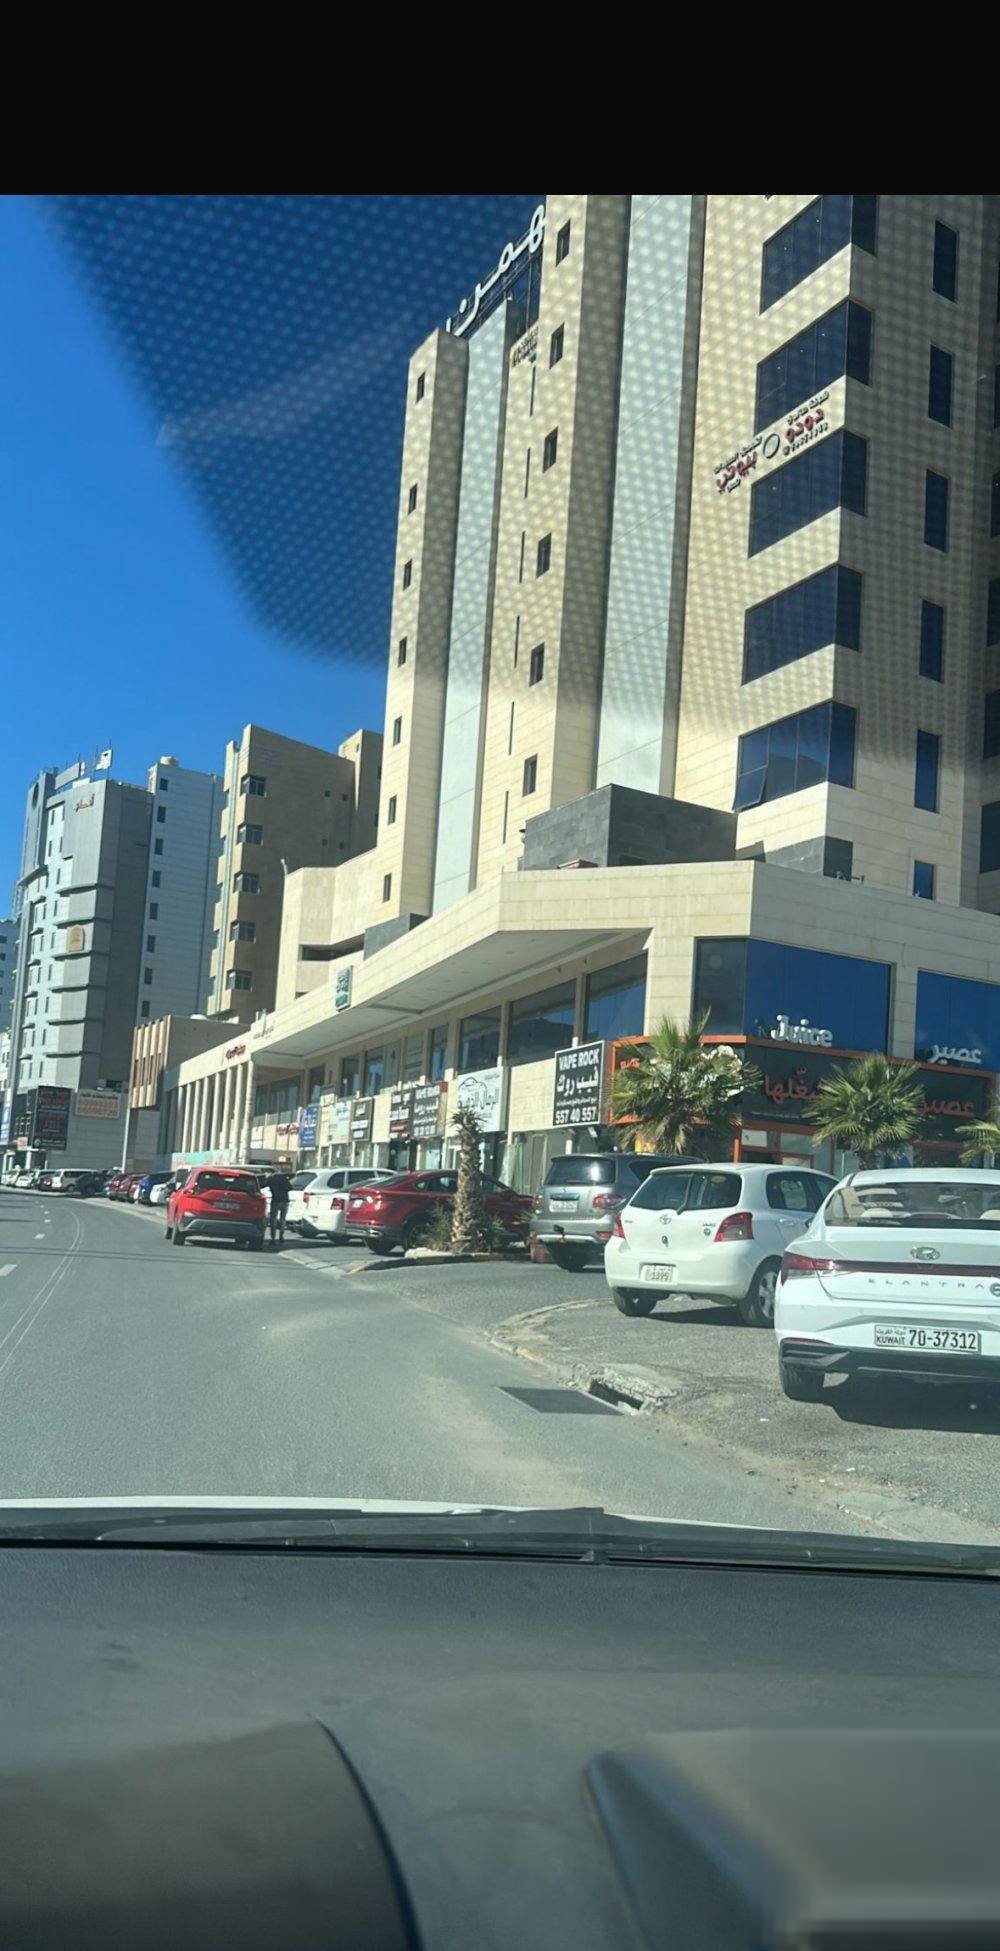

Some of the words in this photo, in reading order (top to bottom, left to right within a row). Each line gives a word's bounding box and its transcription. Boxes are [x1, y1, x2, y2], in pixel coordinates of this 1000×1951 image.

[770, 1014, 834, 1047] Juice
[559, 1053, 578, 1071] VAPE
[578, 1048, 600, 1067] ROCK
[928, 1044, 982, 1065] عصير
[557, 1074, 575, 1097] روك
[576, 1066, 599, 1093] فيب
[555, 1109, 570, 1124] 557
[570, 1107, 581, 1122] 40
[581, 1106, 597, 1121] 557
[868, 1278, 984, 1289] ELANTRA
[876, 1336, 906, 1345] KUWAIT
[909, 1329, 977, 1350] 70-37312
